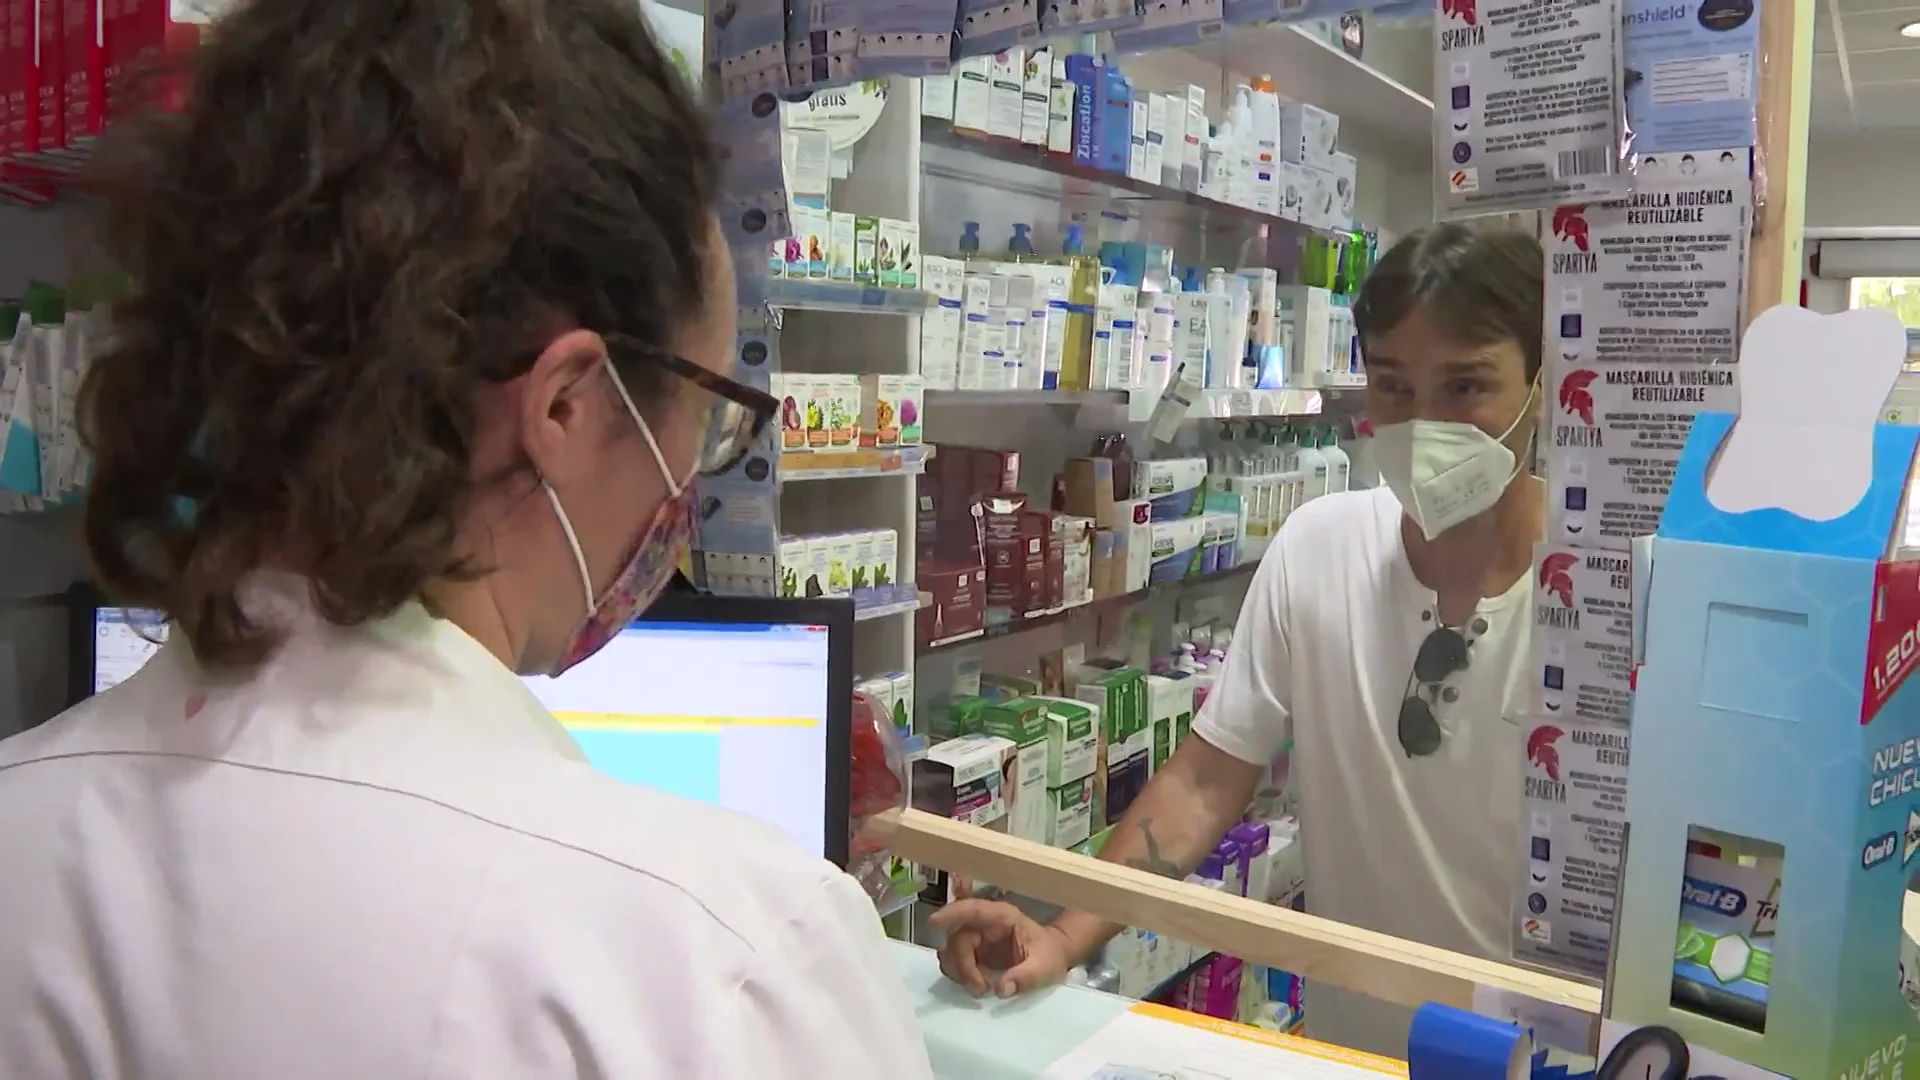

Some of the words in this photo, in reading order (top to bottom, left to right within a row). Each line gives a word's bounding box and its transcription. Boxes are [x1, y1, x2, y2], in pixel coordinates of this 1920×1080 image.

[1442, 25, 1485, 50] SPARTYA
[1077, 84, 1091, 159] Zincation
[1601, 192, 1670, 209] CARILLA
[1677, 189, 1733, 207] HIGIÉNICA
[1627, 208, 1704, 224] REUTILIZABLE
[1553, 253, 1597, 274] SPARTYA
[1606, 370, 1674, 386] MASCARILLA
[1679, 370, 1733, 386] HIGIÉNICA
[1632, 387, 1705, 402] REUTILIZABLE
[1557, 426, 1603, 448] SPARTYA
[1586, 556, 1629, 573] MASCAR
[1538, 605, 1580, 631] SPARTYA
[1525, 776, 1566, 804] SPARTYA
[1756, 899, 1779, 920] Tri
